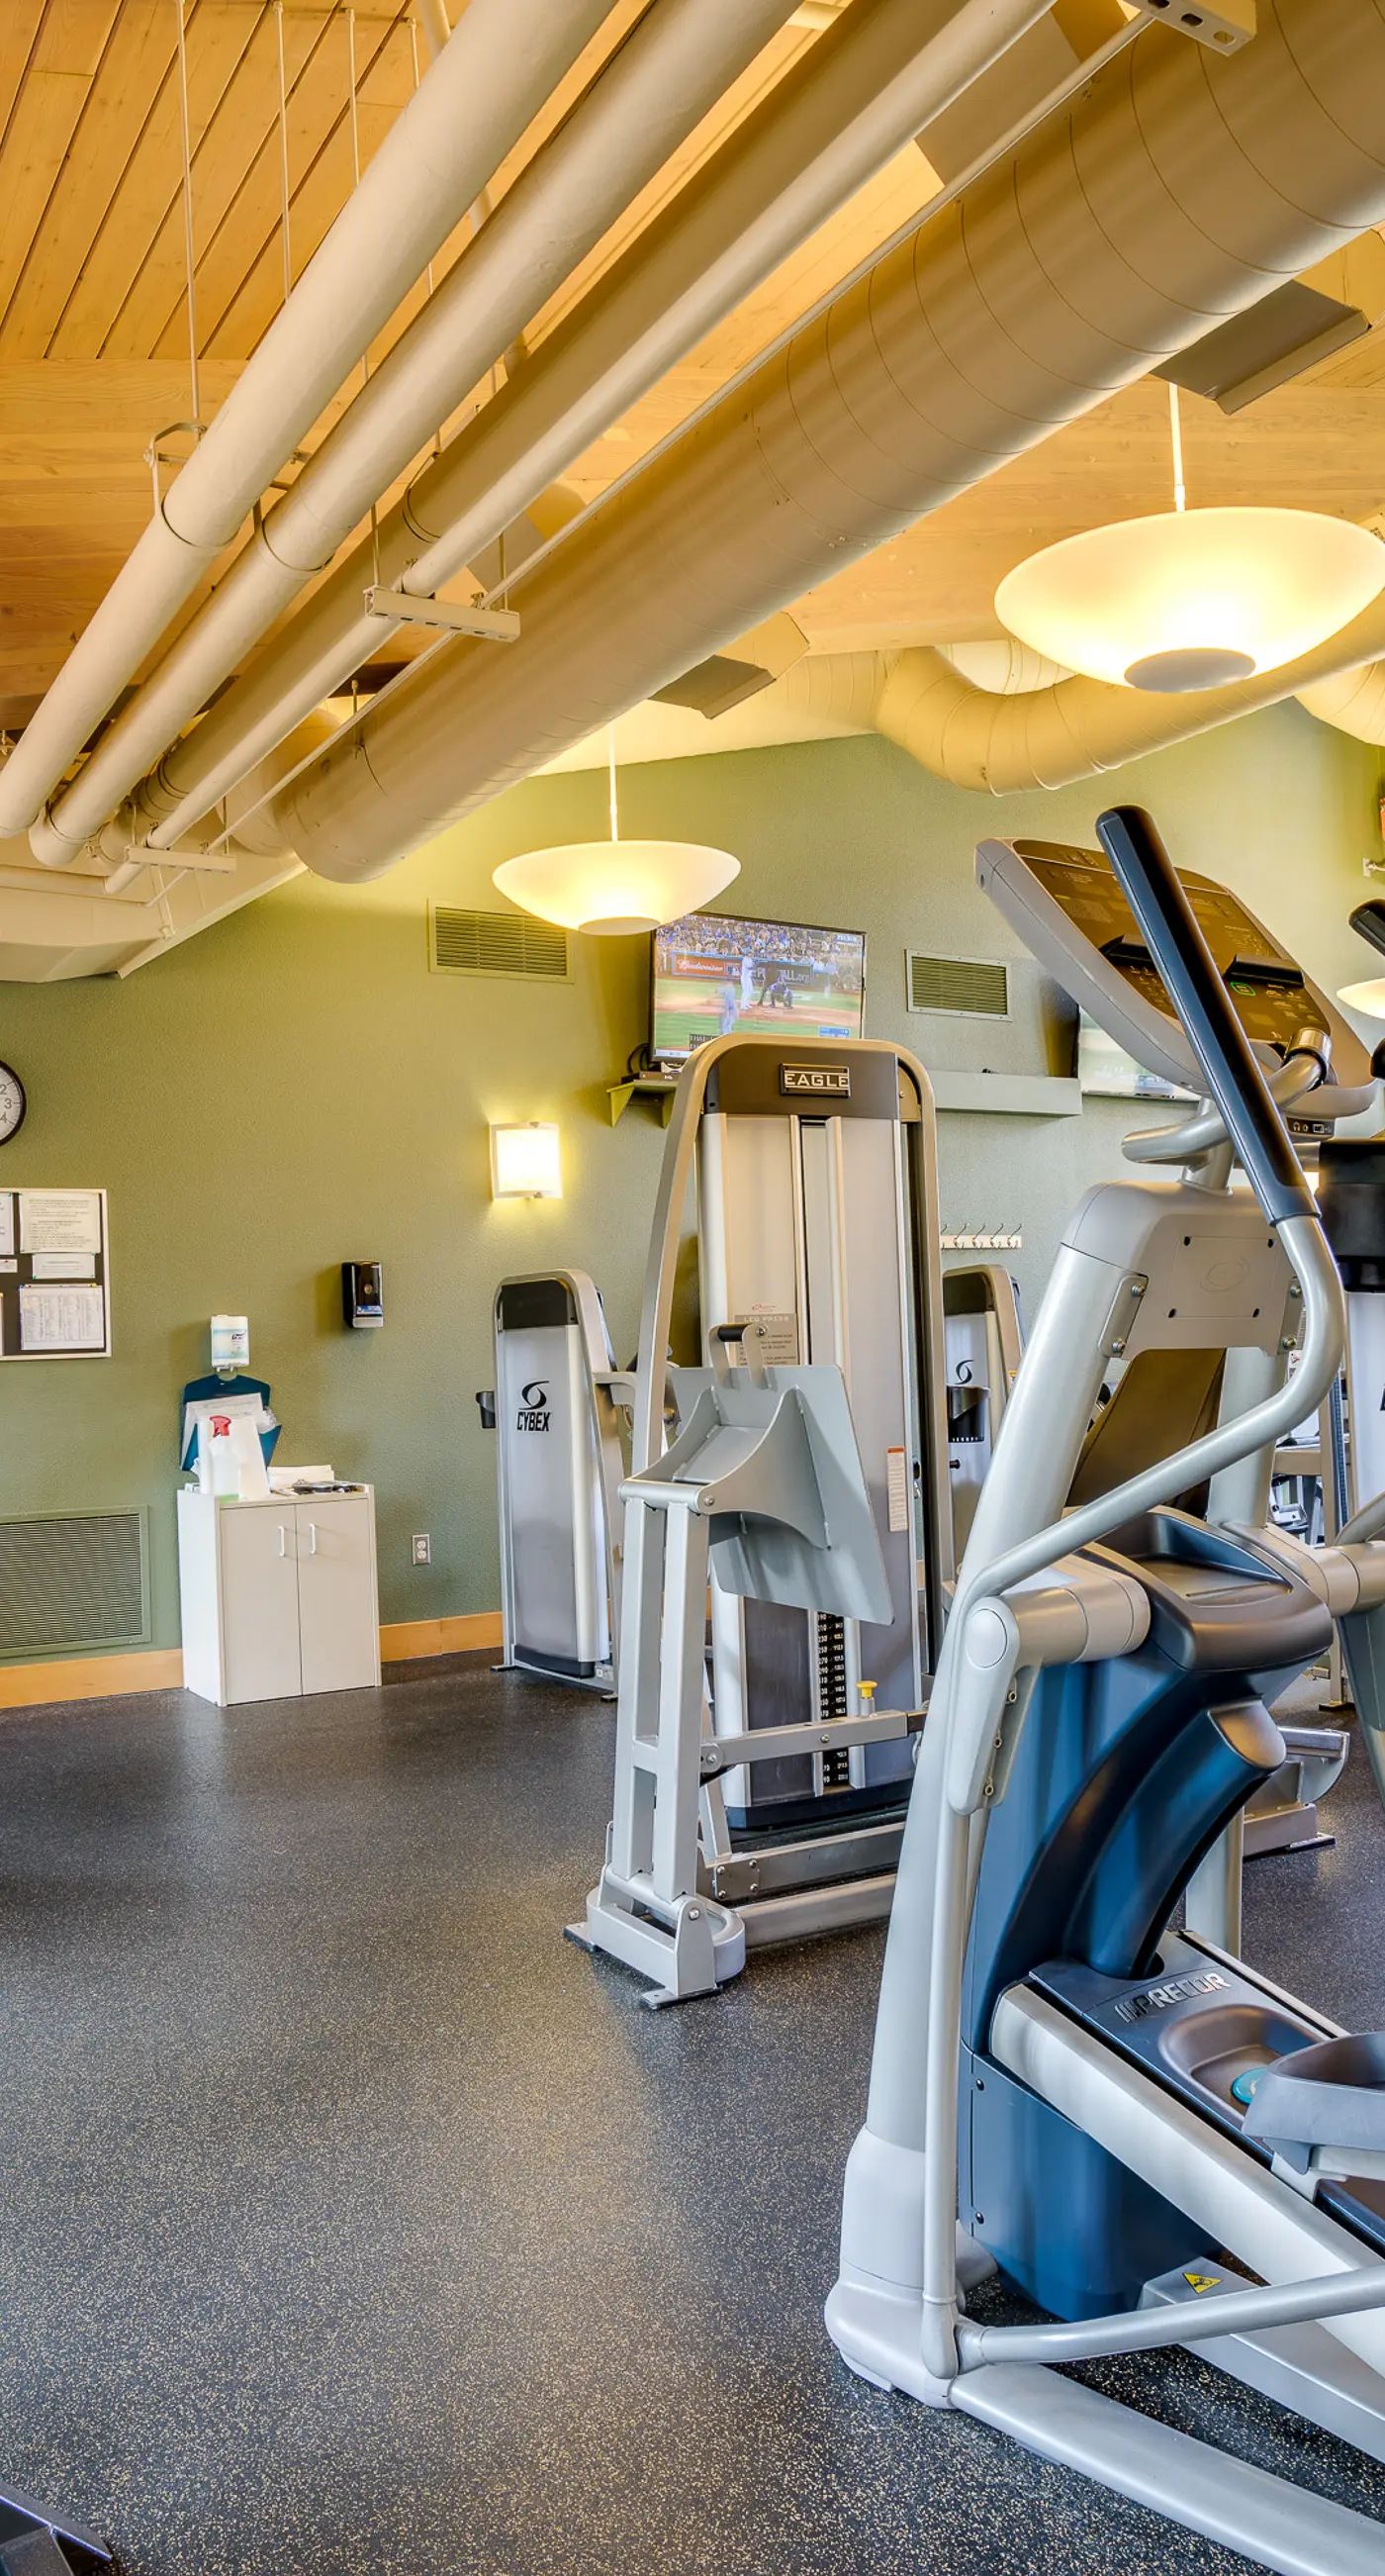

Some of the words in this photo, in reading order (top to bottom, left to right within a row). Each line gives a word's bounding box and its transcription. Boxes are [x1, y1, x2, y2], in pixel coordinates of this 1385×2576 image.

[785, 1073, 850, 1088] EAGLE
[4, 1097, 13, 1109] 3
[516, 1411, 551, 1432] CYBEX
[1131, 1972, 1233, 2020] PRECOR
